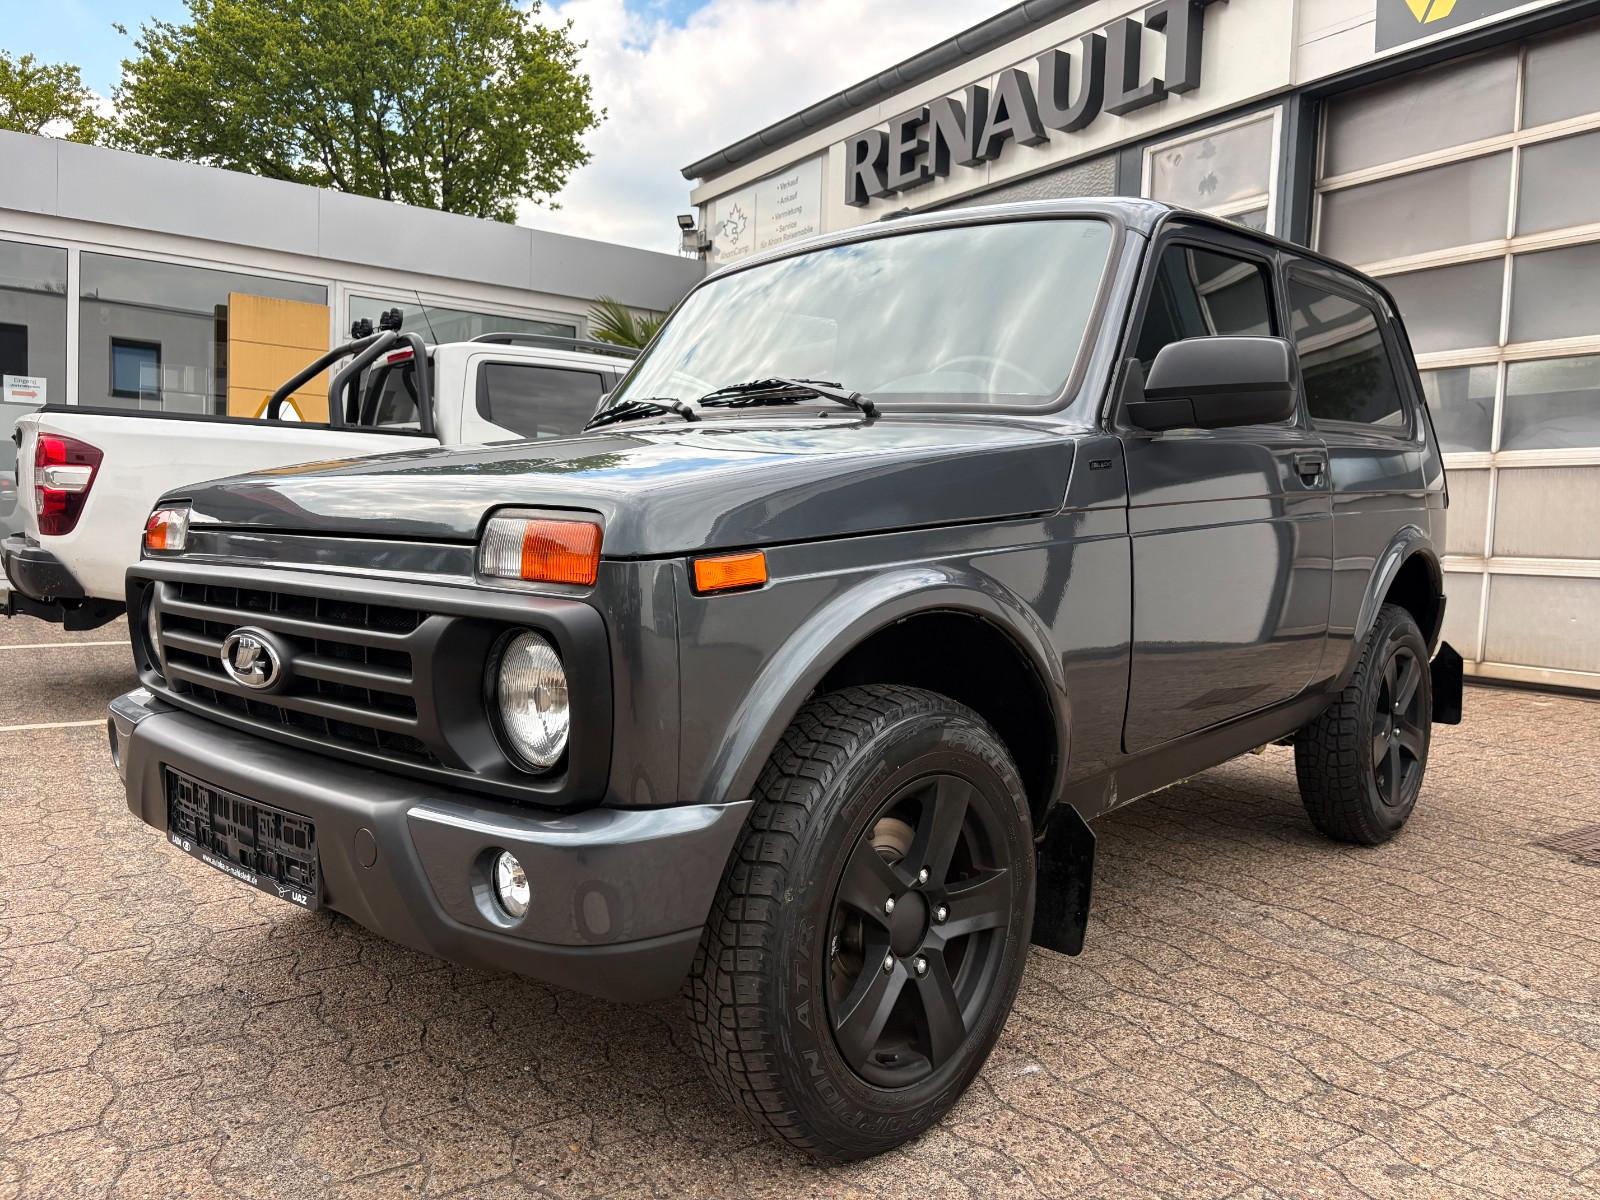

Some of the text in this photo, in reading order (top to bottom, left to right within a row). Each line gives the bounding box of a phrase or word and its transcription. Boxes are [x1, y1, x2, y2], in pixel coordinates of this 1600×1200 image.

[845, 0, 1229, 207] RENAULT
[780, 176, 799, 190] Verkauf
[780, 192, 798, 205] Ankauf
[775, 205, 802, 221] Vermietung
[779, 221, 798, 233] Service
[292, 892, 308, 905] UAZ
